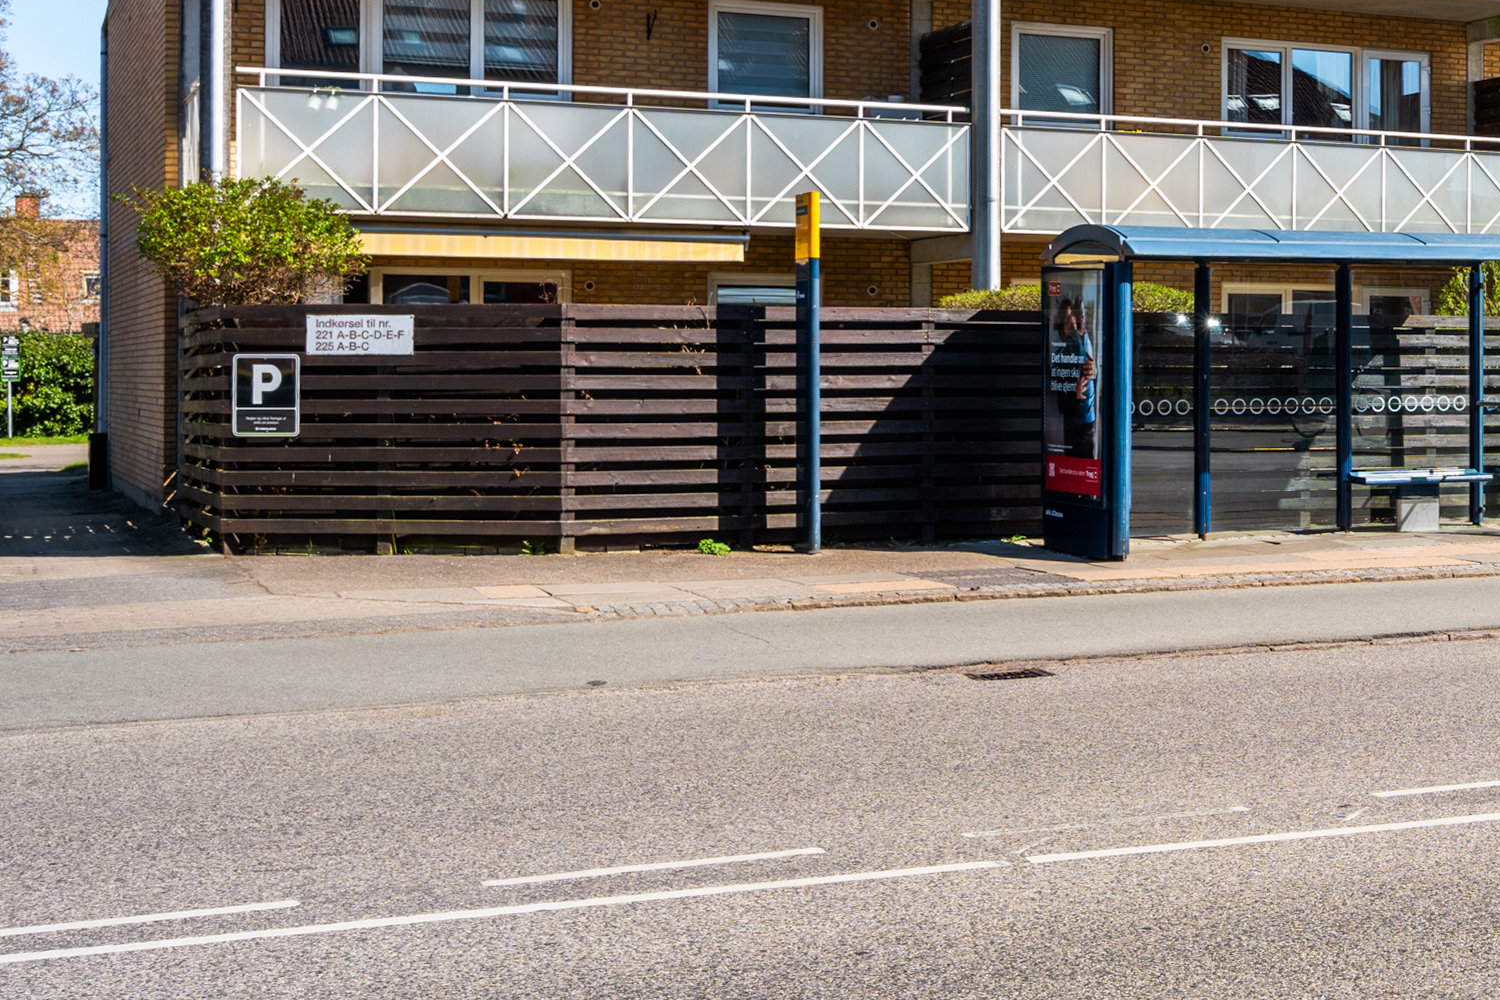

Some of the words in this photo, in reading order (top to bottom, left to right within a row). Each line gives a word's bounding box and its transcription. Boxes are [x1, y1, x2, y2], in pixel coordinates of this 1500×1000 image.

[315, 319, 363, 328] Indkørsel
[366, 319, 376, 328] til
[378, 320, 391, 328] nr.
[315, 330, 333, 340] 221
[336, 330, 404, 340] A-B-C-D-E-F
[315, 341, 334, 351] 225
[336, 341, 369, 351] A-B-C
[1051, 352, 1060, 363] Det
[252, 364, 282, 404] P
